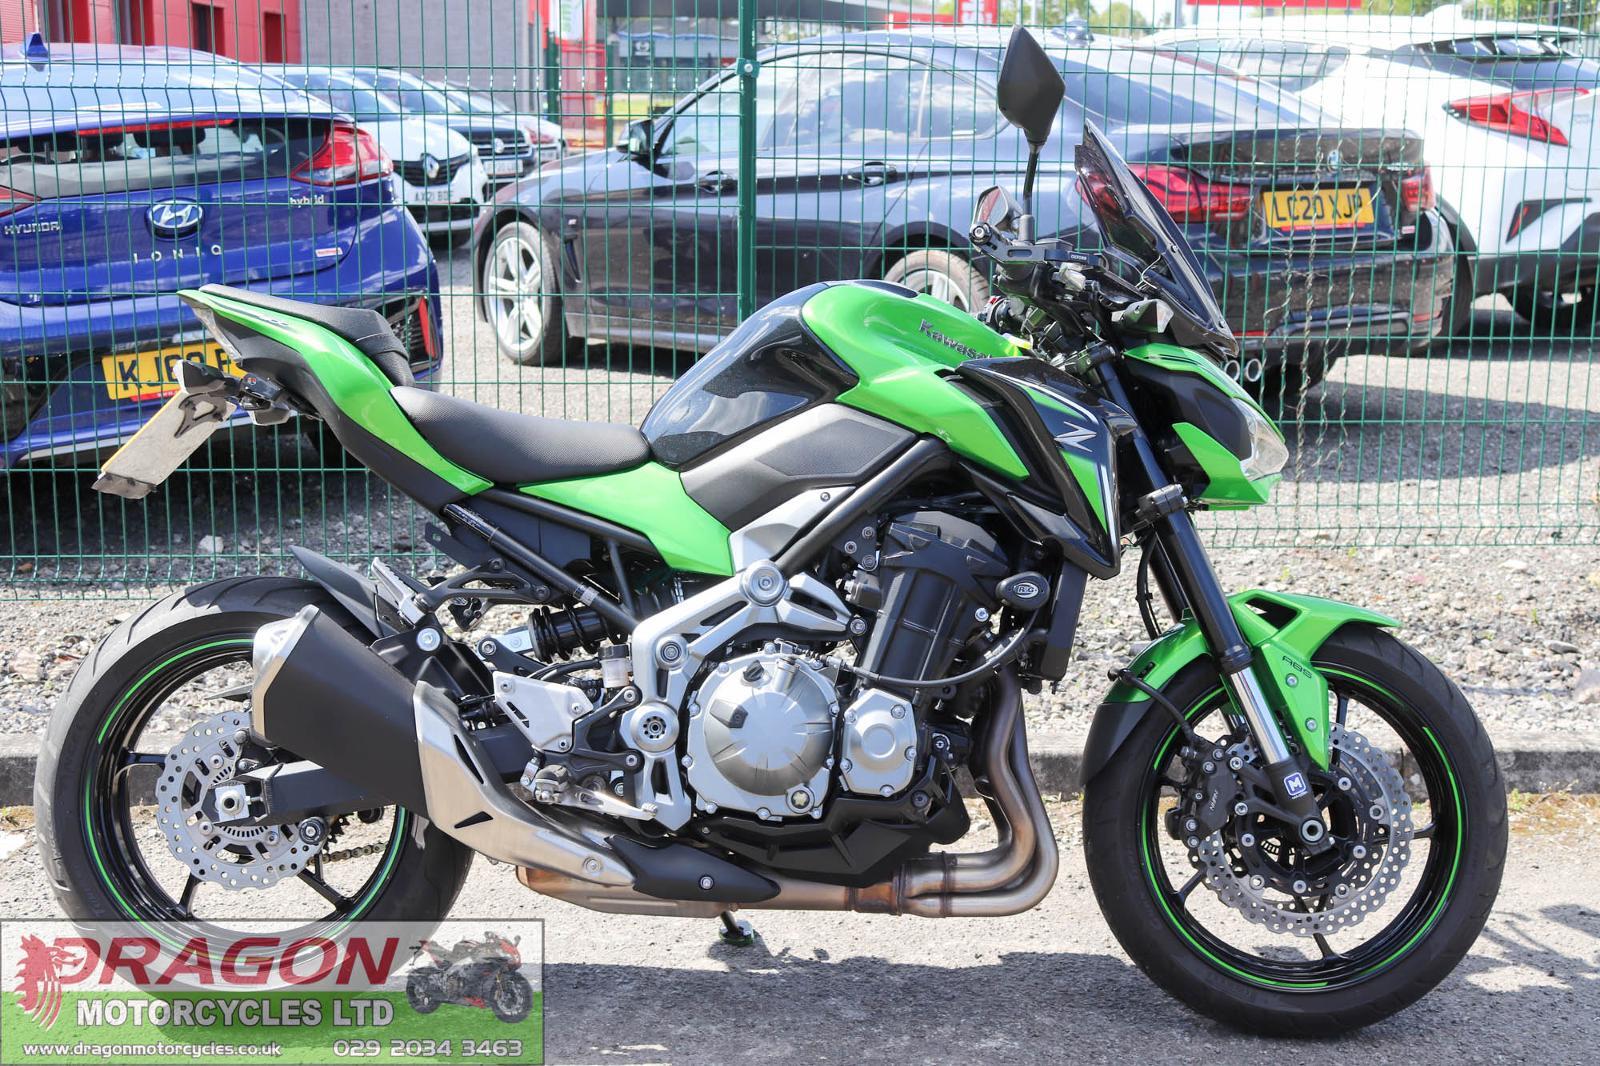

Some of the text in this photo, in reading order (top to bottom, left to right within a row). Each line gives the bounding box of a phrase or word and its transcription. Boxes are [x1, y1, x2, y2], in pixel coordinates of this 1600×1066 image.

[1273, 192, 1363, 222] LC20 XJP
[133, 244, 223, 264] IONIQ
[1282, 655, 1313, 679] ABS
